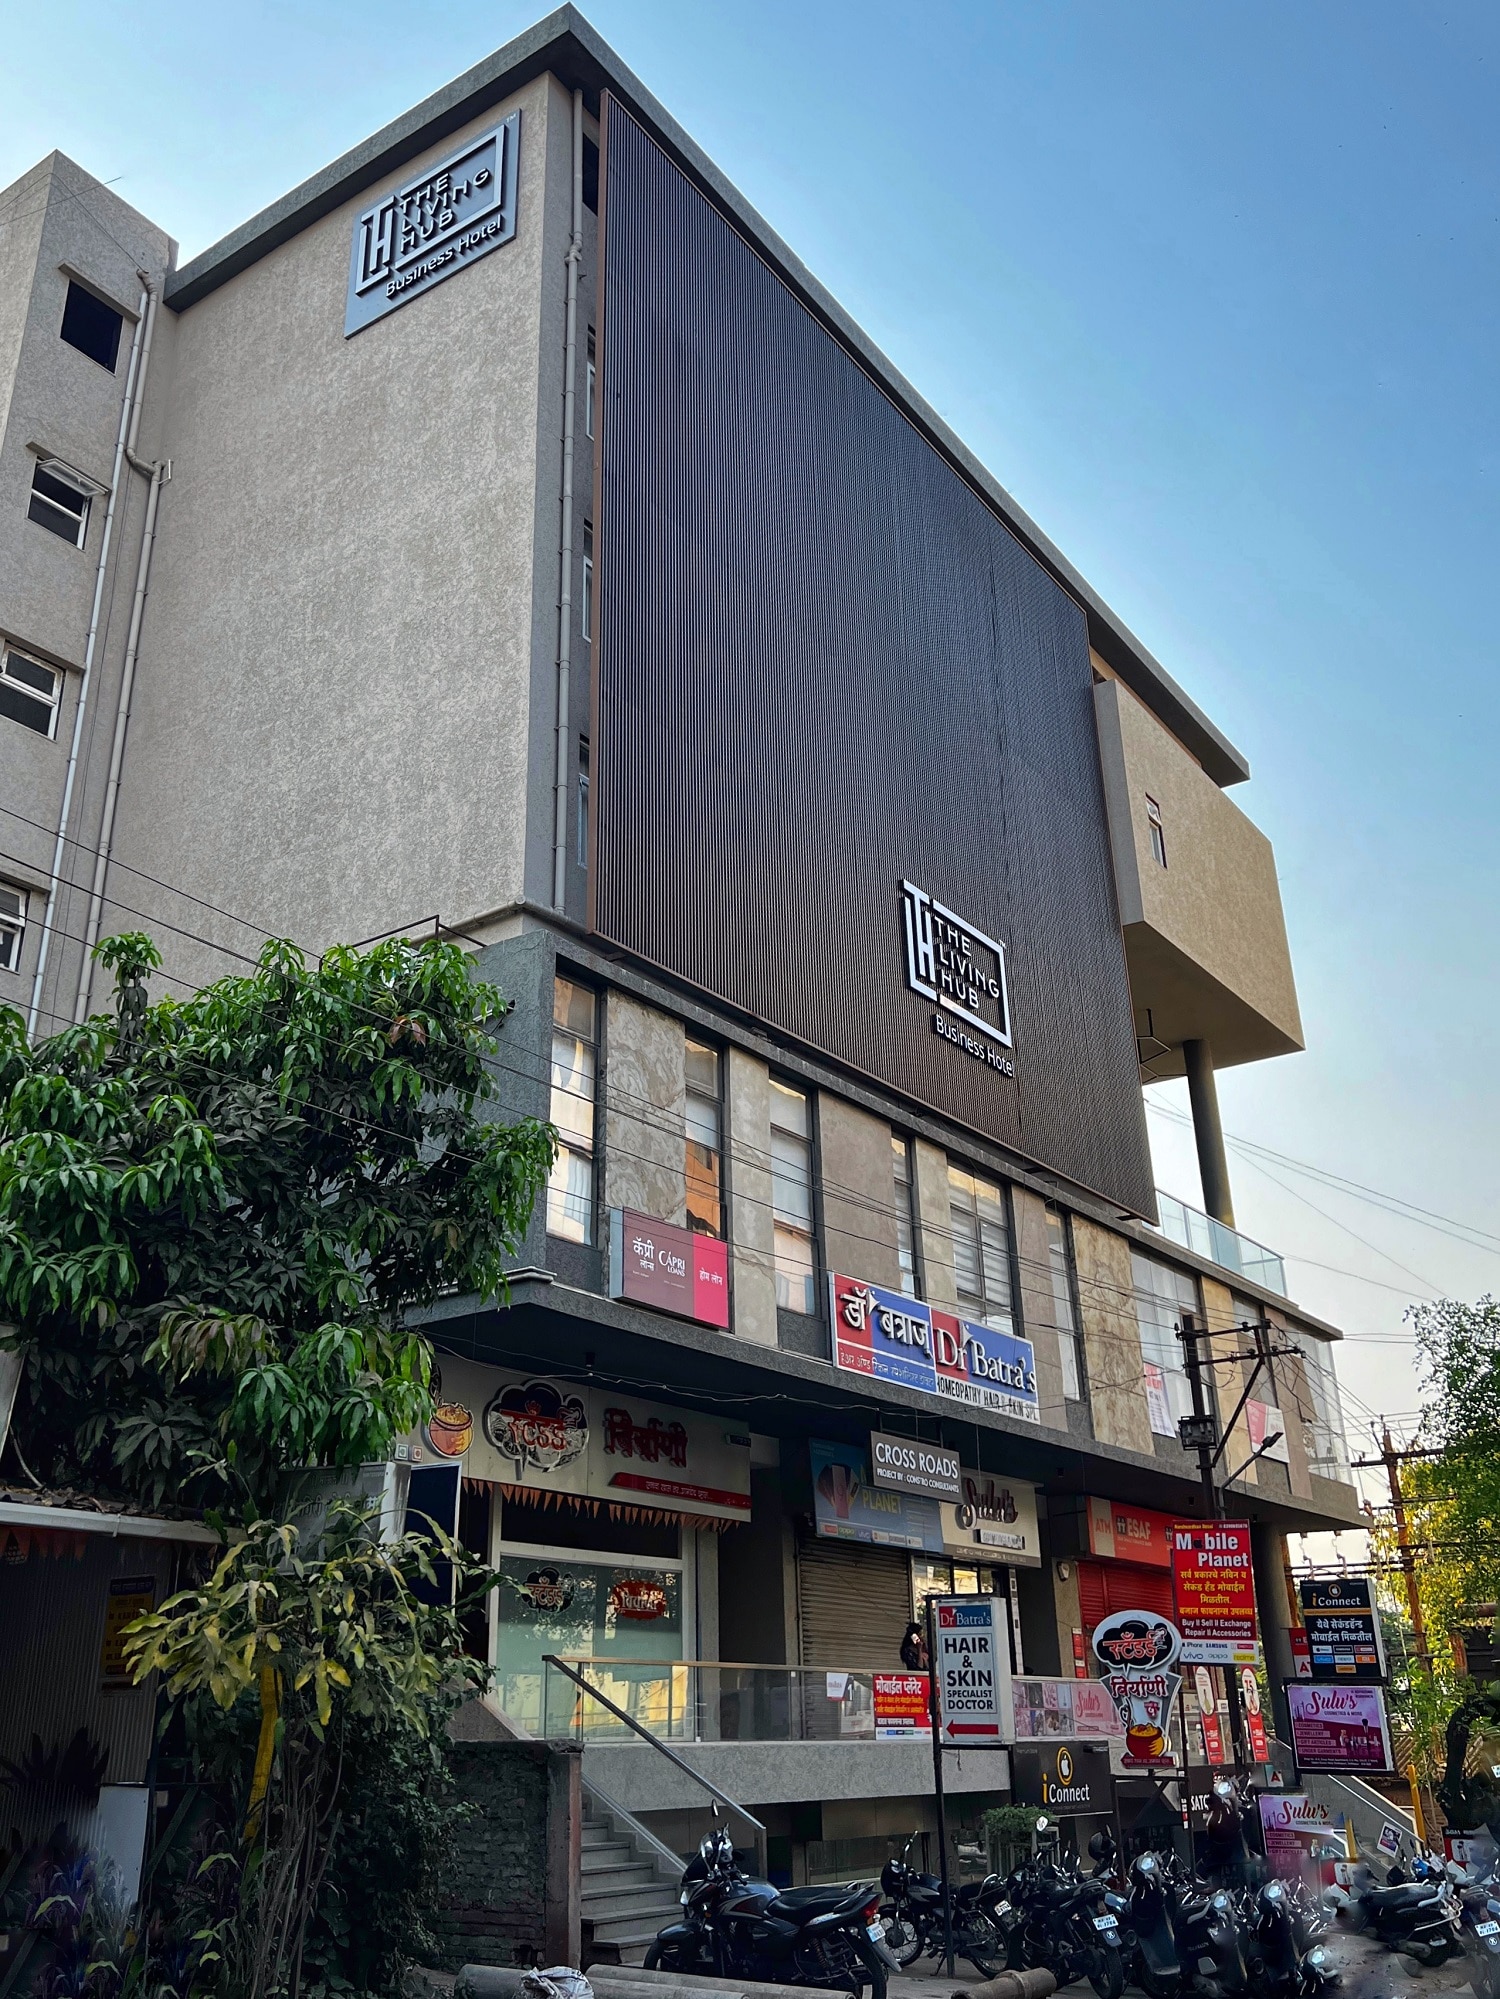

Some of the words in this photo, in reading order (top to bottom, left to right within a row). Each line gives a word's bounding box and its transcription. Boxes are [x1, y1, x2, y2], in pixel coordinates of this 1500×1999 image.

[400, 173, 449, 214] THE
[401, 168, 489, 233] LIVING
[400, 208, 453, 252] HUB
[386, 247, 453, 297] Business
[458, 215, 502, 251] Hotel
[934, 916, 972, 957] THE
[939, 943, 1000, 999] LIVING
[941, 969, 979, 1009] HUB
[935, 1014, 985, 1060] Business
[987, 1045, 1015, 1077] Hotel
[667, 1265, 686, 1278] LOANS
[935, 1326, 968, 1371] Dr
[969, 1336, 1038, 1394] Batra's
[875, 1442, 916, 1470] CROSS
[918, 1453, 958, 1479] ROADS
[1095, 1518, 1111, 1533] ATM
[1126, 1517, 1151, 1540] ESAF
[1198, 1552, 1249, 1567] Planet
[1318, 1596, 1361, 1607] Connect
[939, 1612, 955, 1626] Dr
[955, 1612, 991, 1625] Batra's
[1182, 1619, 1195, 1628] Buy
[1201, 1619, 1214, 1627] Sell
[1219, 1620, 1252, 1629] Exchange
[1185, 1629, 1206, 1638] Repair
[1212, 1629, 1251, 1638] Accessories
[944, 1637, 989, 1654] HAIR
[962, 1655, 973, 1668] &
[947, 1670, 992, 1687] SKIN
[947, 1690, 992, 1698] SPECIALIST
[1305, 1690, 1358, 1716] Sulu's
[948, 1700, 993, 1710] DOCTOR
[1049, 1783, 1090, 1803] Connect
[1277, 1800, 1329, 1825] Sulu's
